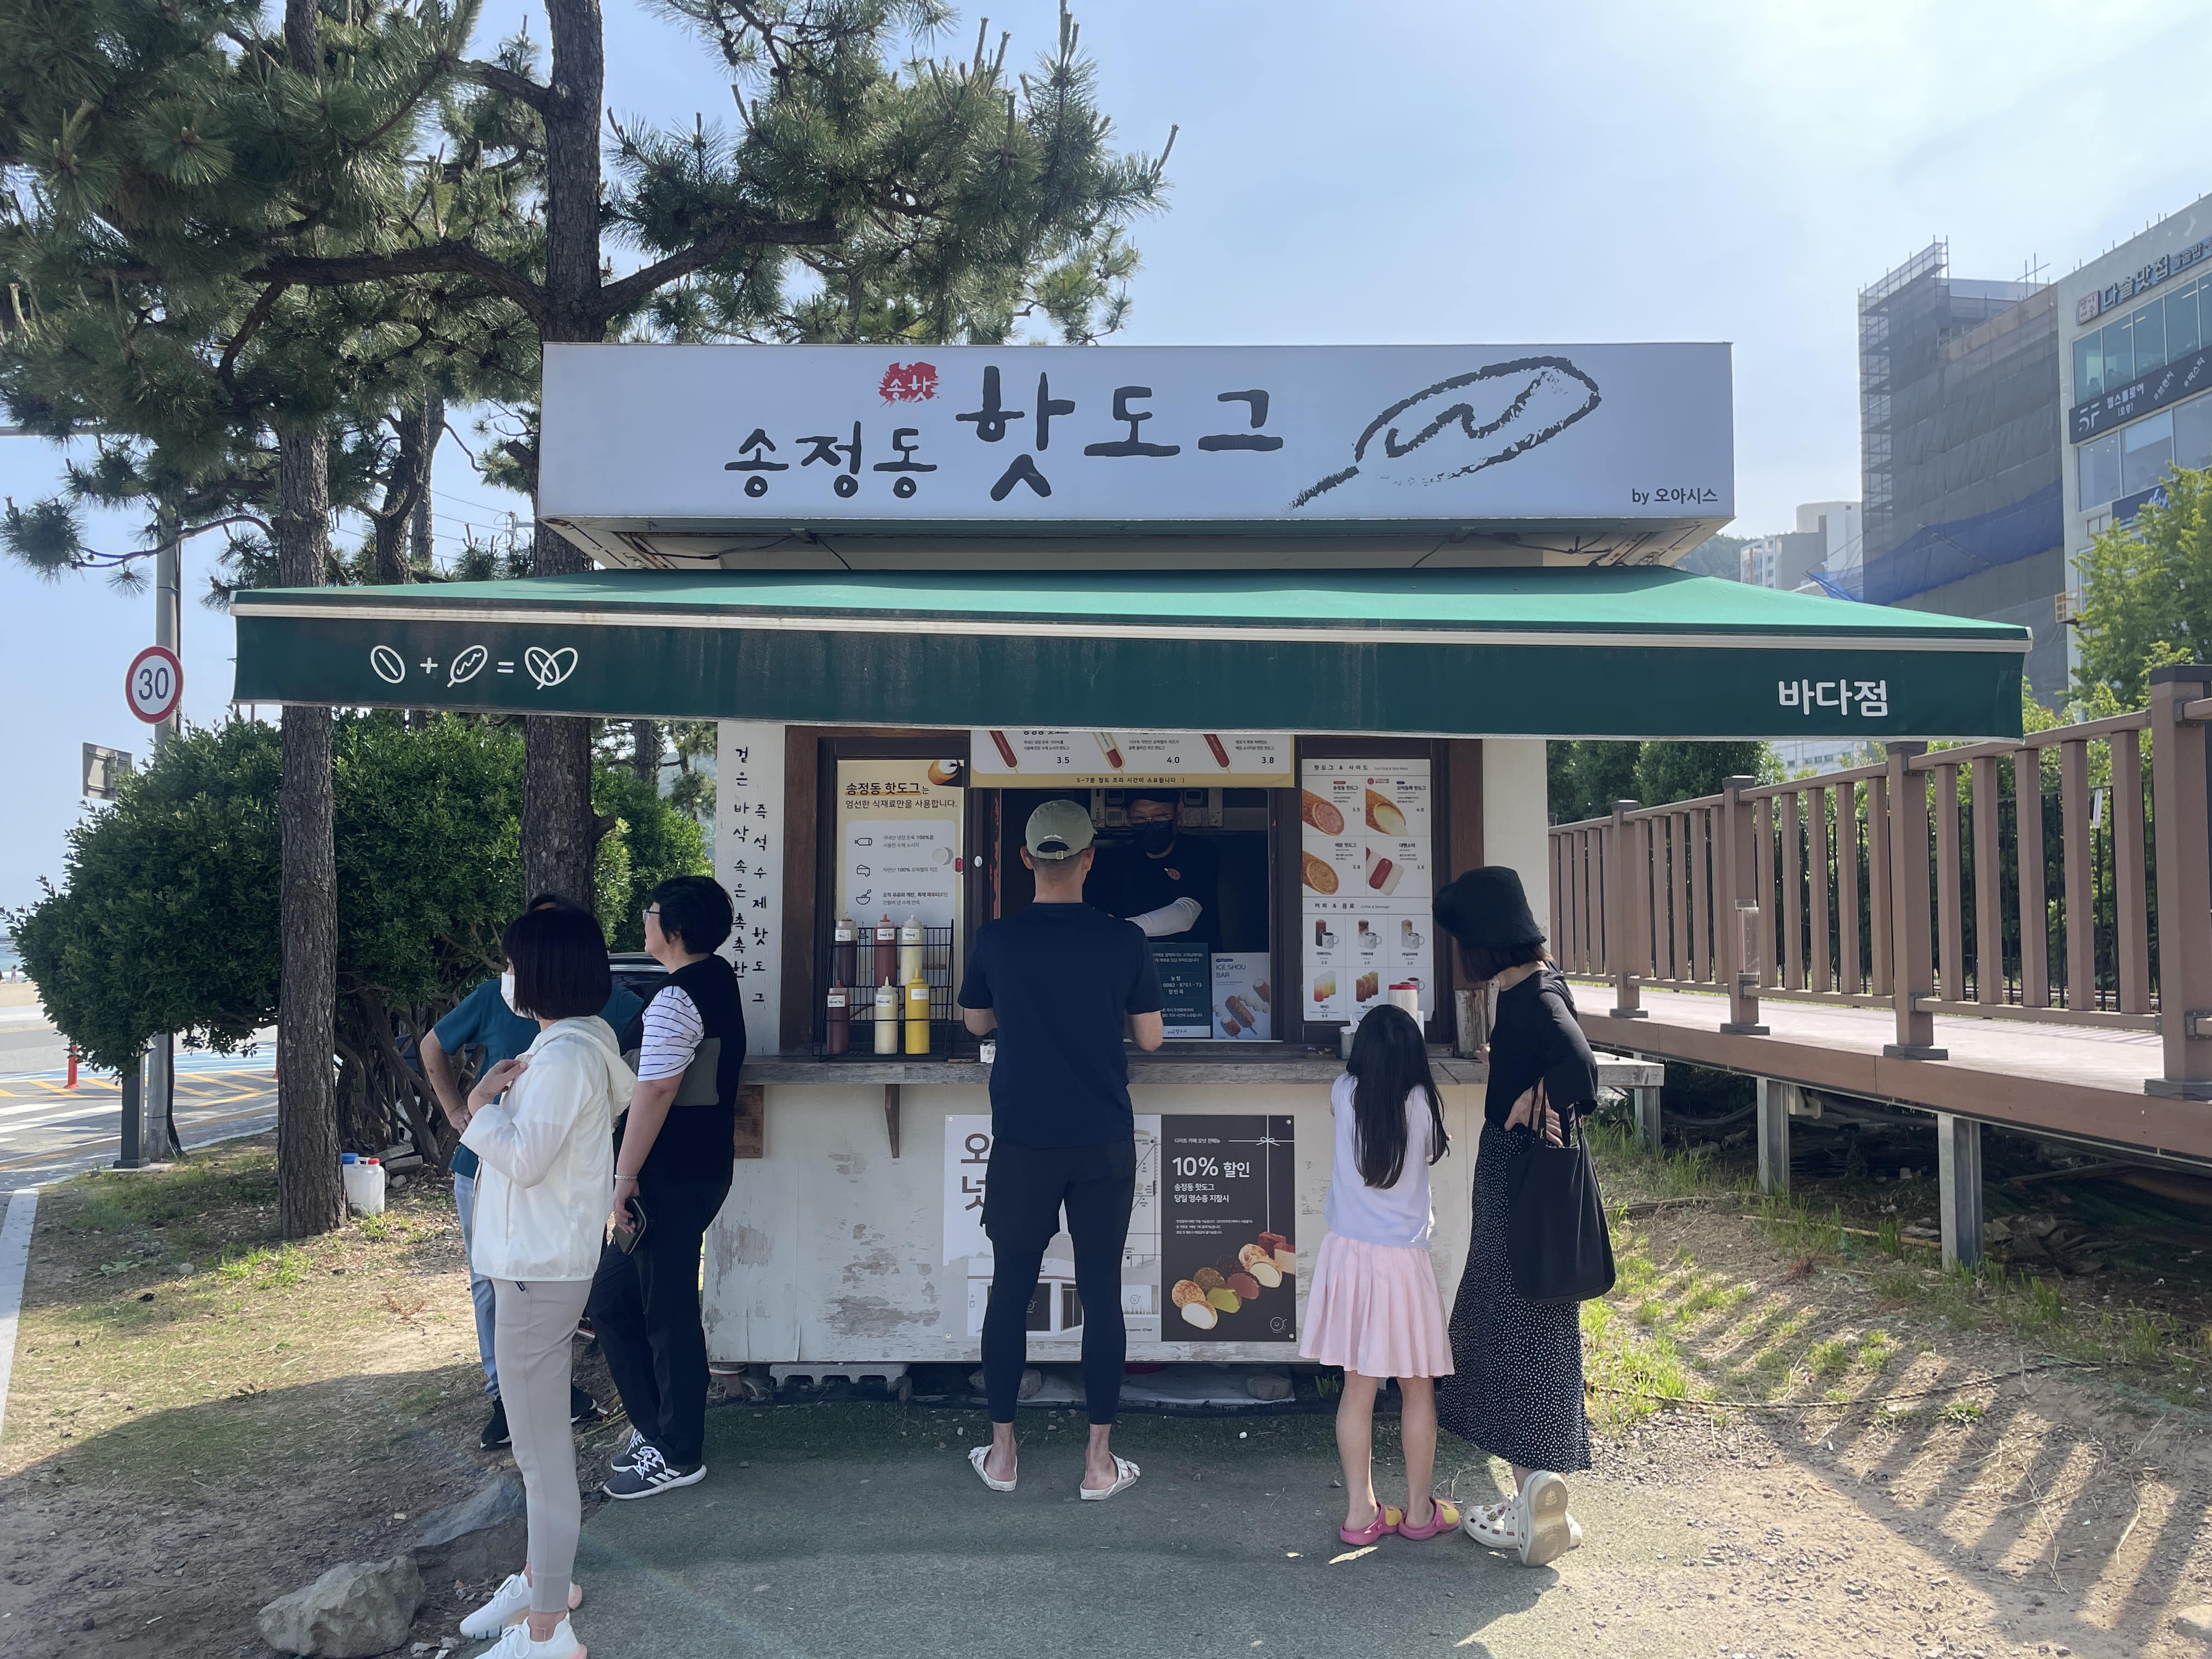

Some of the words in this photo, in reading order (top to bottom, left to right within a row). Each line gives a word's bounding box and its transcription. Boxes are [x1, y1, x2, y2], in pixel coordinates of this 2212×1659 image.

[887, 375, 931, 402] 송핫
[724, 421, 938, 498] 송정동
[955, 365, 1283, 501] 핫도그
[1632, 488, 1649, 505] by
[1655, 488, 1718, 504] 오아시스
[138, 667, 169, 701] 30
[1779, 679, 1888, 716] 바다점
[845, 782, 882, 795] 송정동
[845, 800, 870, 809] 엄선한
[872, 800, 912, 809] 식재료만을
[915, 799, 957, 809] 사용합니다.
[733, 802, 749, 843] 바삭
[754, 804, 767, 851] 즉석
[733, 859, 747, 898] 속은
[752, 867, 767, 909] 수제
[732, 913, 747, 978] 촉촉한
[751, 927, 768, 1002] 핫도그
[1172, 1157, 1218, 1176] 10%
[1223, 1161, 1250, 1178] 할인
[1174, 1183, 1194, 1192] 송정동
[1195, 1183, 1215, 1192] 핫도그
[1174, 1194, 1187, 1203] 당일
[1188, 1194, 1208, 1203] 영수증
[1210, 1194, 1229, 1203] 지참시
